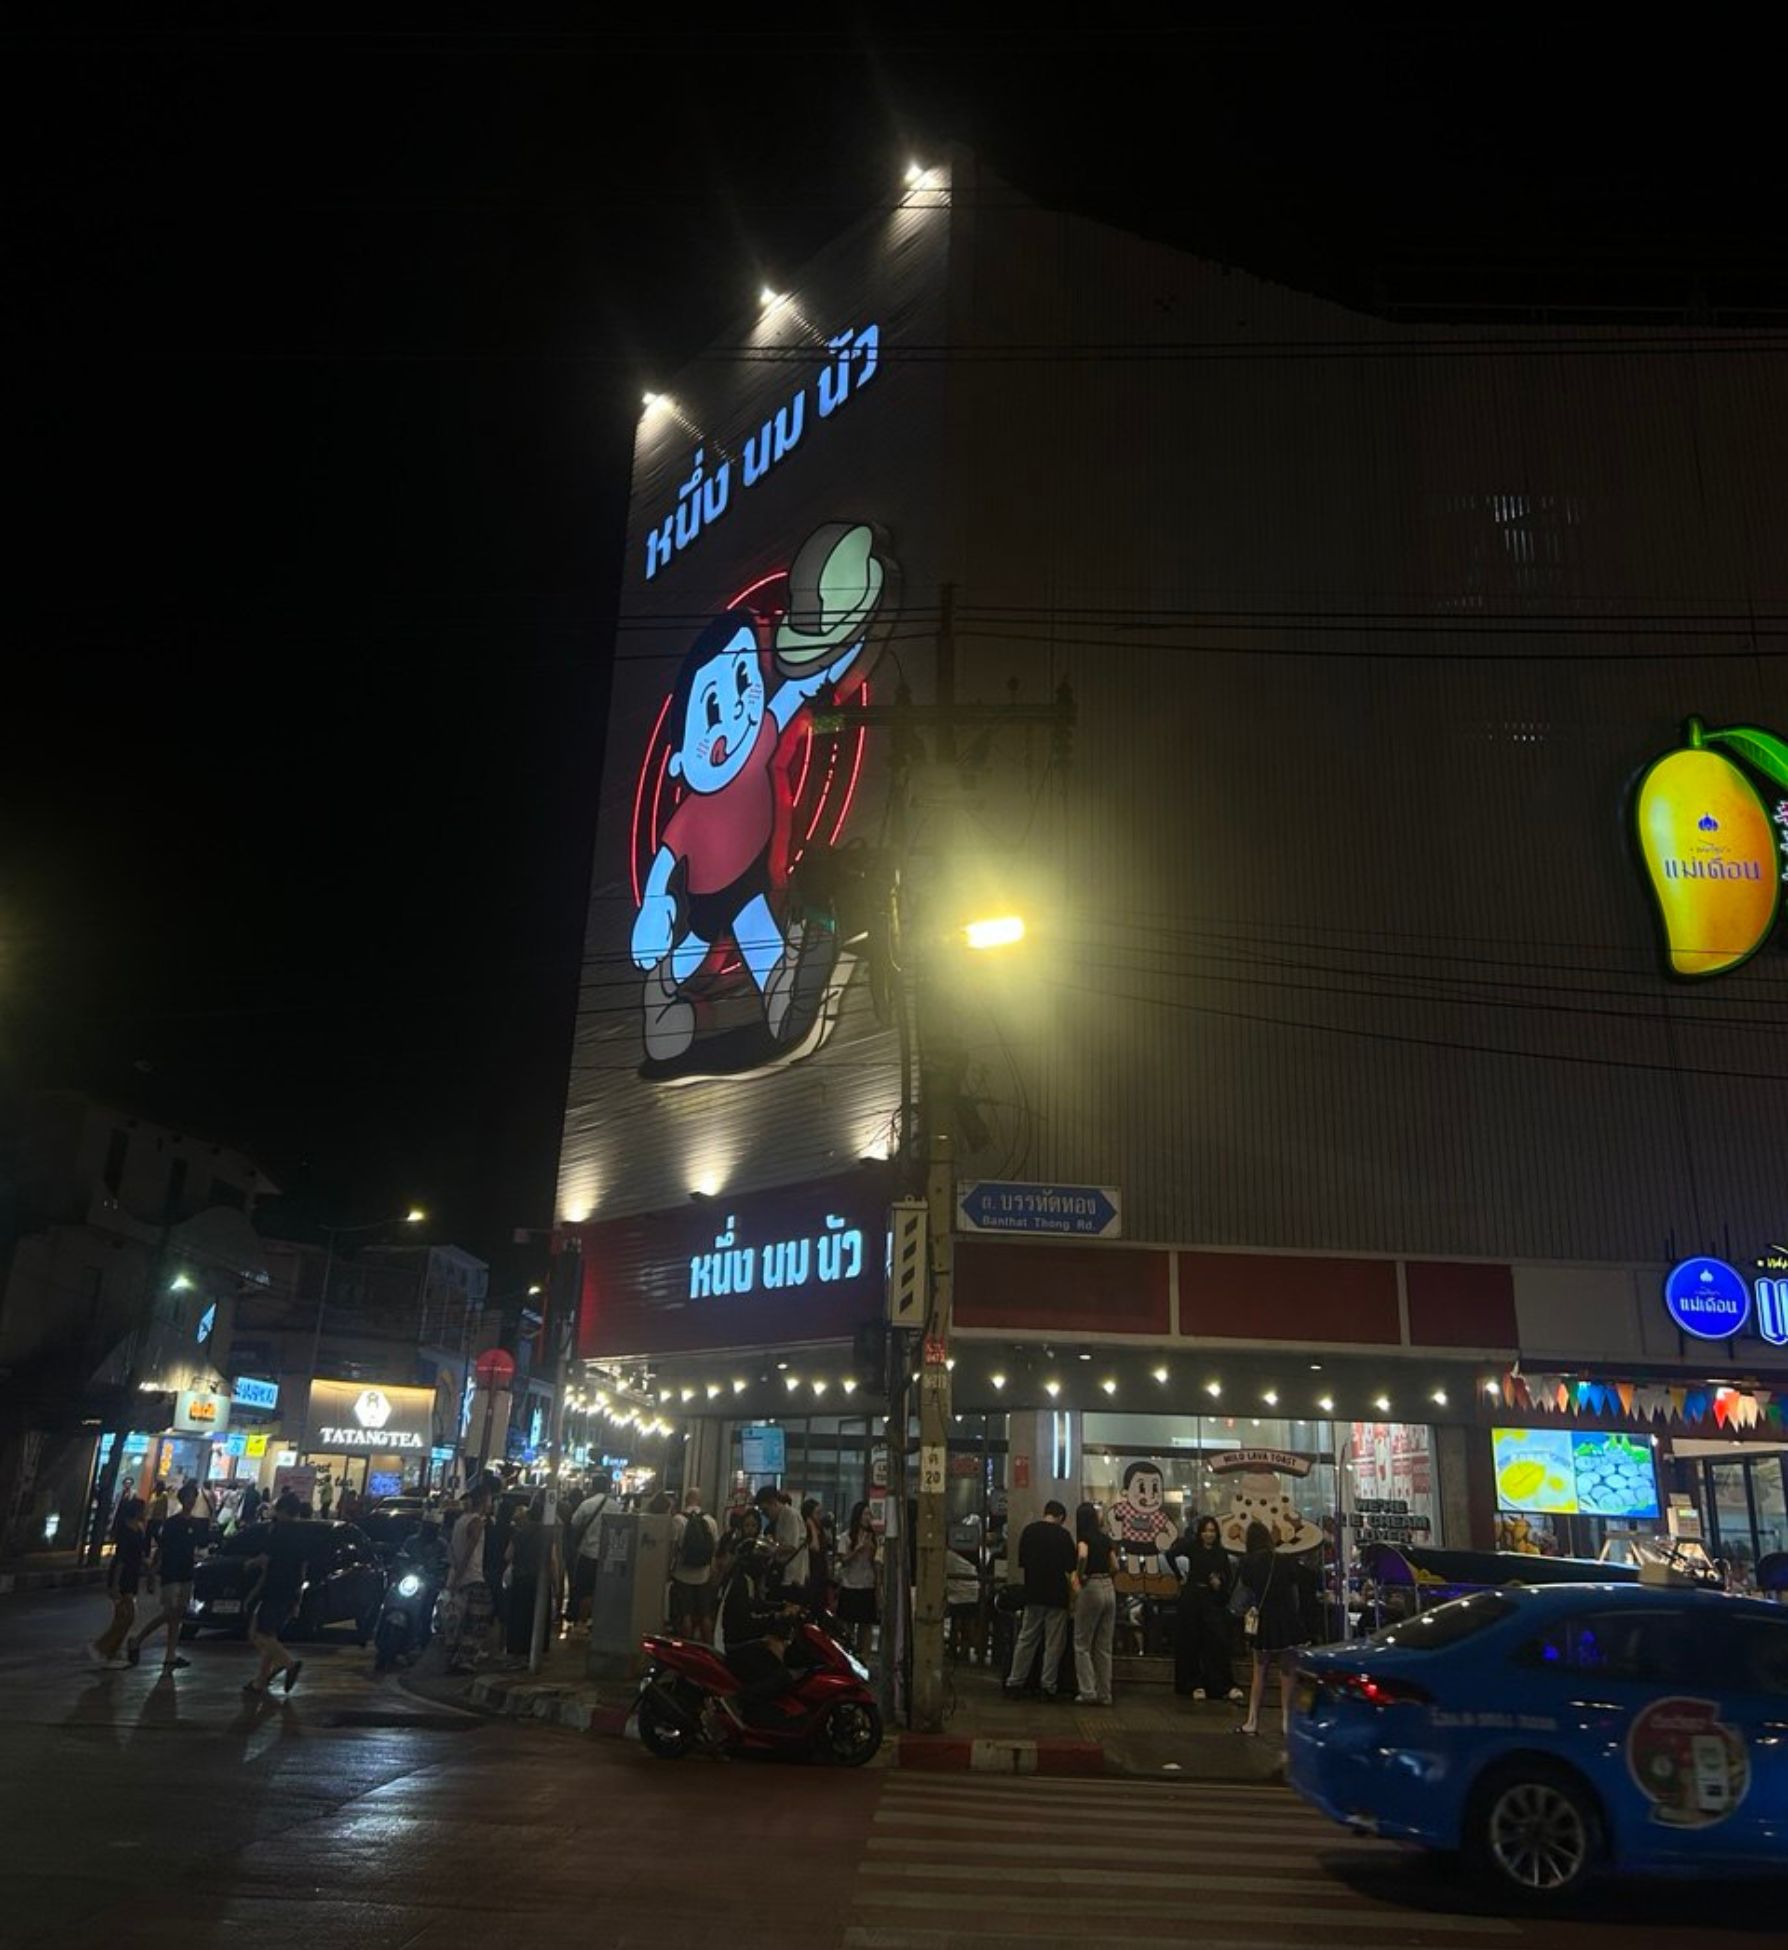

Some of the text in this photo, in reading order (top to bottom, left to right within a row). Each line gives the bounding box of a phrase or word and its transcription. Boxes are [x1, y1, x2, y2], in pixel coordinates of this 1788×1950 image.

[645, 323, 880, 580] หนึ่ง นม นัว
[1001, 1189, 1096, 1215] บรรทัดทอง
[982, 1216, 1096, 1231] Banthat Thong Rd.
[690, 1215, 755, 1299] หนึ่ง
[763, 1238, 810, 1290] นม
[817, 1214, 863, 1282] นัว
[1247, 1451, 1268, 1461] LAVA
[1271, 1453, 1297, 1466] TOAST
[926, 1471, 941, 1484] 20
[1371, 1515, 1429, 1531] CREAM
[1355, 1529, 1408, 1543] LOVER
